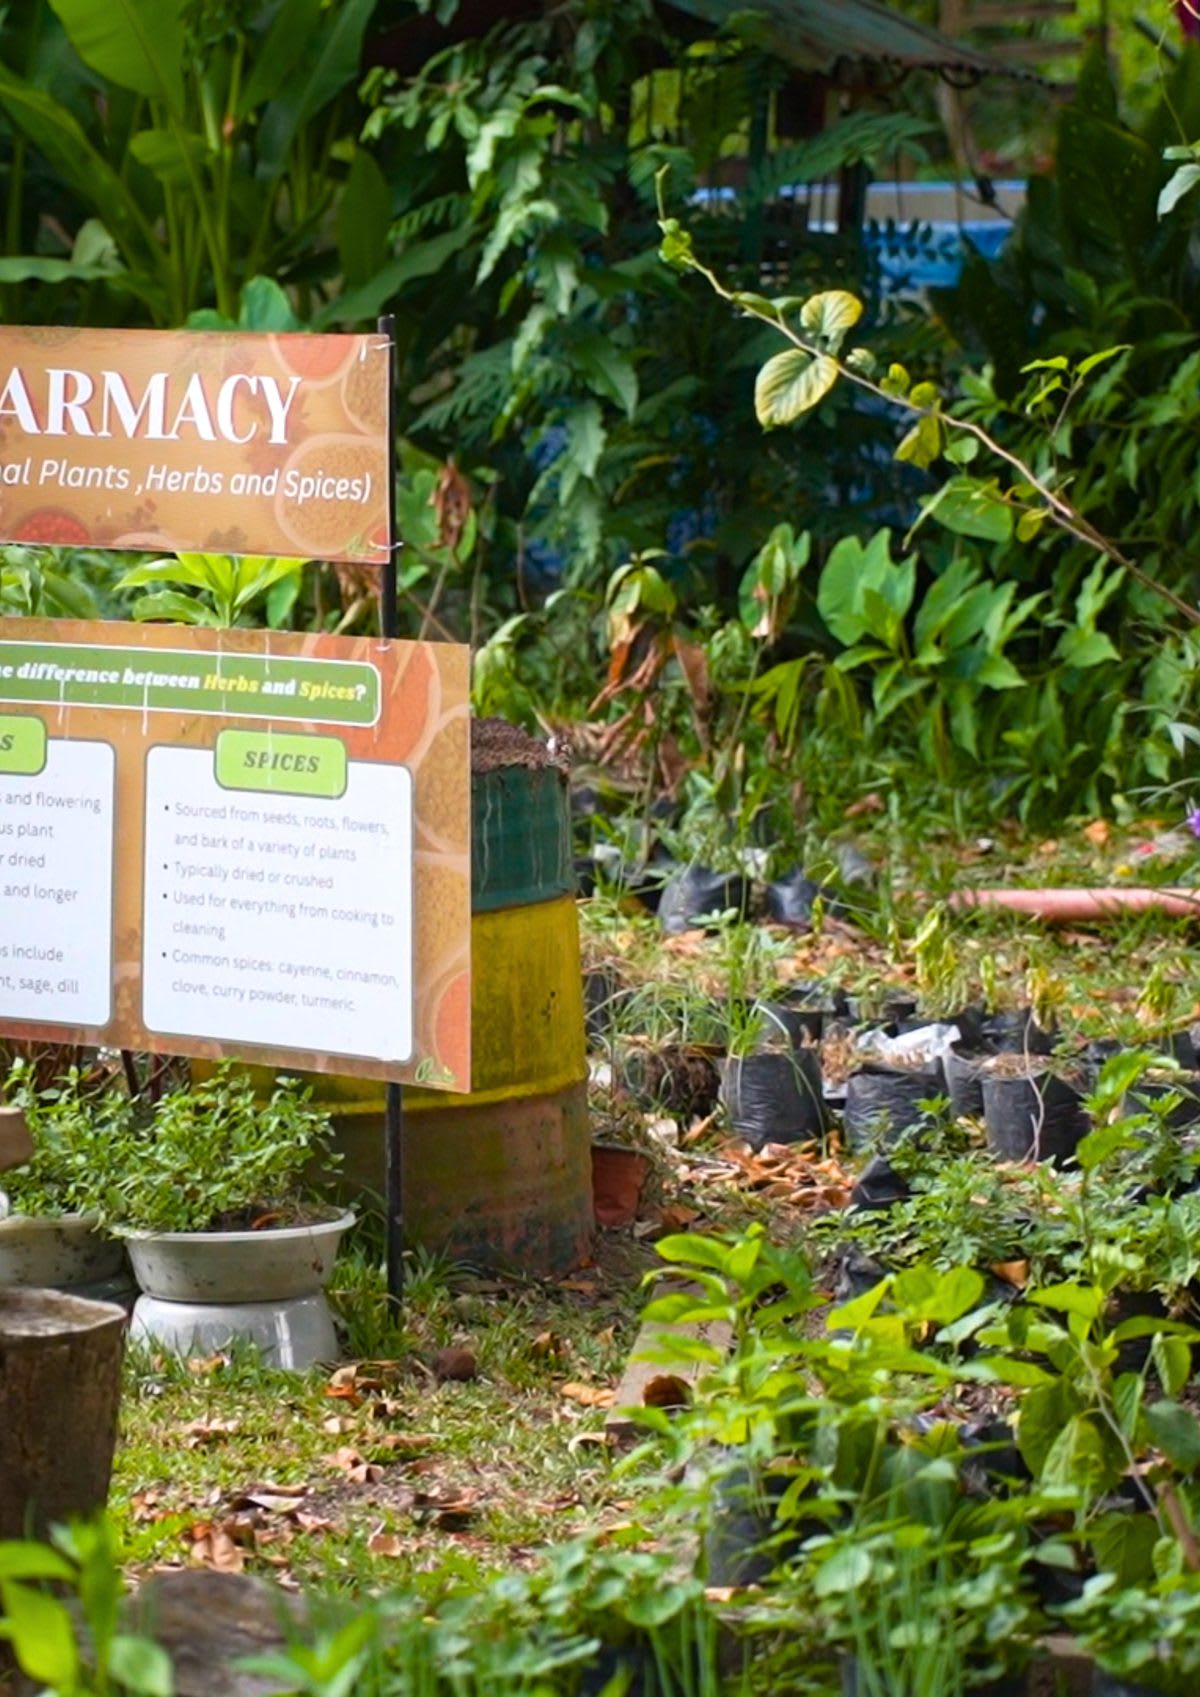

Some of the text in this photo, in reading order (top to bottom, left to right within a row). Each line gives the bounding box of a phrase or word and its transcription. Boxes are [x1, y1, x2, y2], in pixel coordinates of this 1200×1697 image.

[40, 459, 129, 490] Plants
[230, 473, 276, 496] and
[282, 467, 371, 505] Spices)
[17, 662, 119, 684] difference
[122, 669, 199, 690] between
[203, 675, 259, 694] Herbs
[261, 679, 296, 696] and
[299, 680, 367, 701] Spices?
[243, 750, 320, 773] SPICES
[5, 790, 32, 806] and
[36, 791, 102, 813] flowering
[17, 823, 54, 838] plant
[175, 802, 227, 820] Sourced
[230, 806, 260, 822] from
[263, 811, 301, 827] seeds,
[342, 816, 390, 837] flowers,
[175, 832, 198, 847] and
[201, 834, 228, 849] bark
[232, 837, 244, 851] of
[258, 840, 300, 858] variety
[303, 845, 316, 857] of
[319, 847, 357, 862] plants
[8, 853, 46, 868] dried
[174, 861, 334, 890] Typically dried or crushed
[4, 884, 30, 898] and
[34, 884, 78, 904] longer
[173, 890, 395, 928] Used for everything from cooking to
[172, 921, 226, 941] cleaning
[12, 944, 64, 963] include
[172, 949, 230, 968] Common
[278, 960, 333, 981] cayenne,
[336, 968, 400, 989] cinnamon,
[19, 979, 55, 993] sage,
[57, 979, 79, 994] dill
[172, 979, 209, 996] clove,
[212, 984, 246, 1002] curry
[249, 988, 298, 1007] powder,
